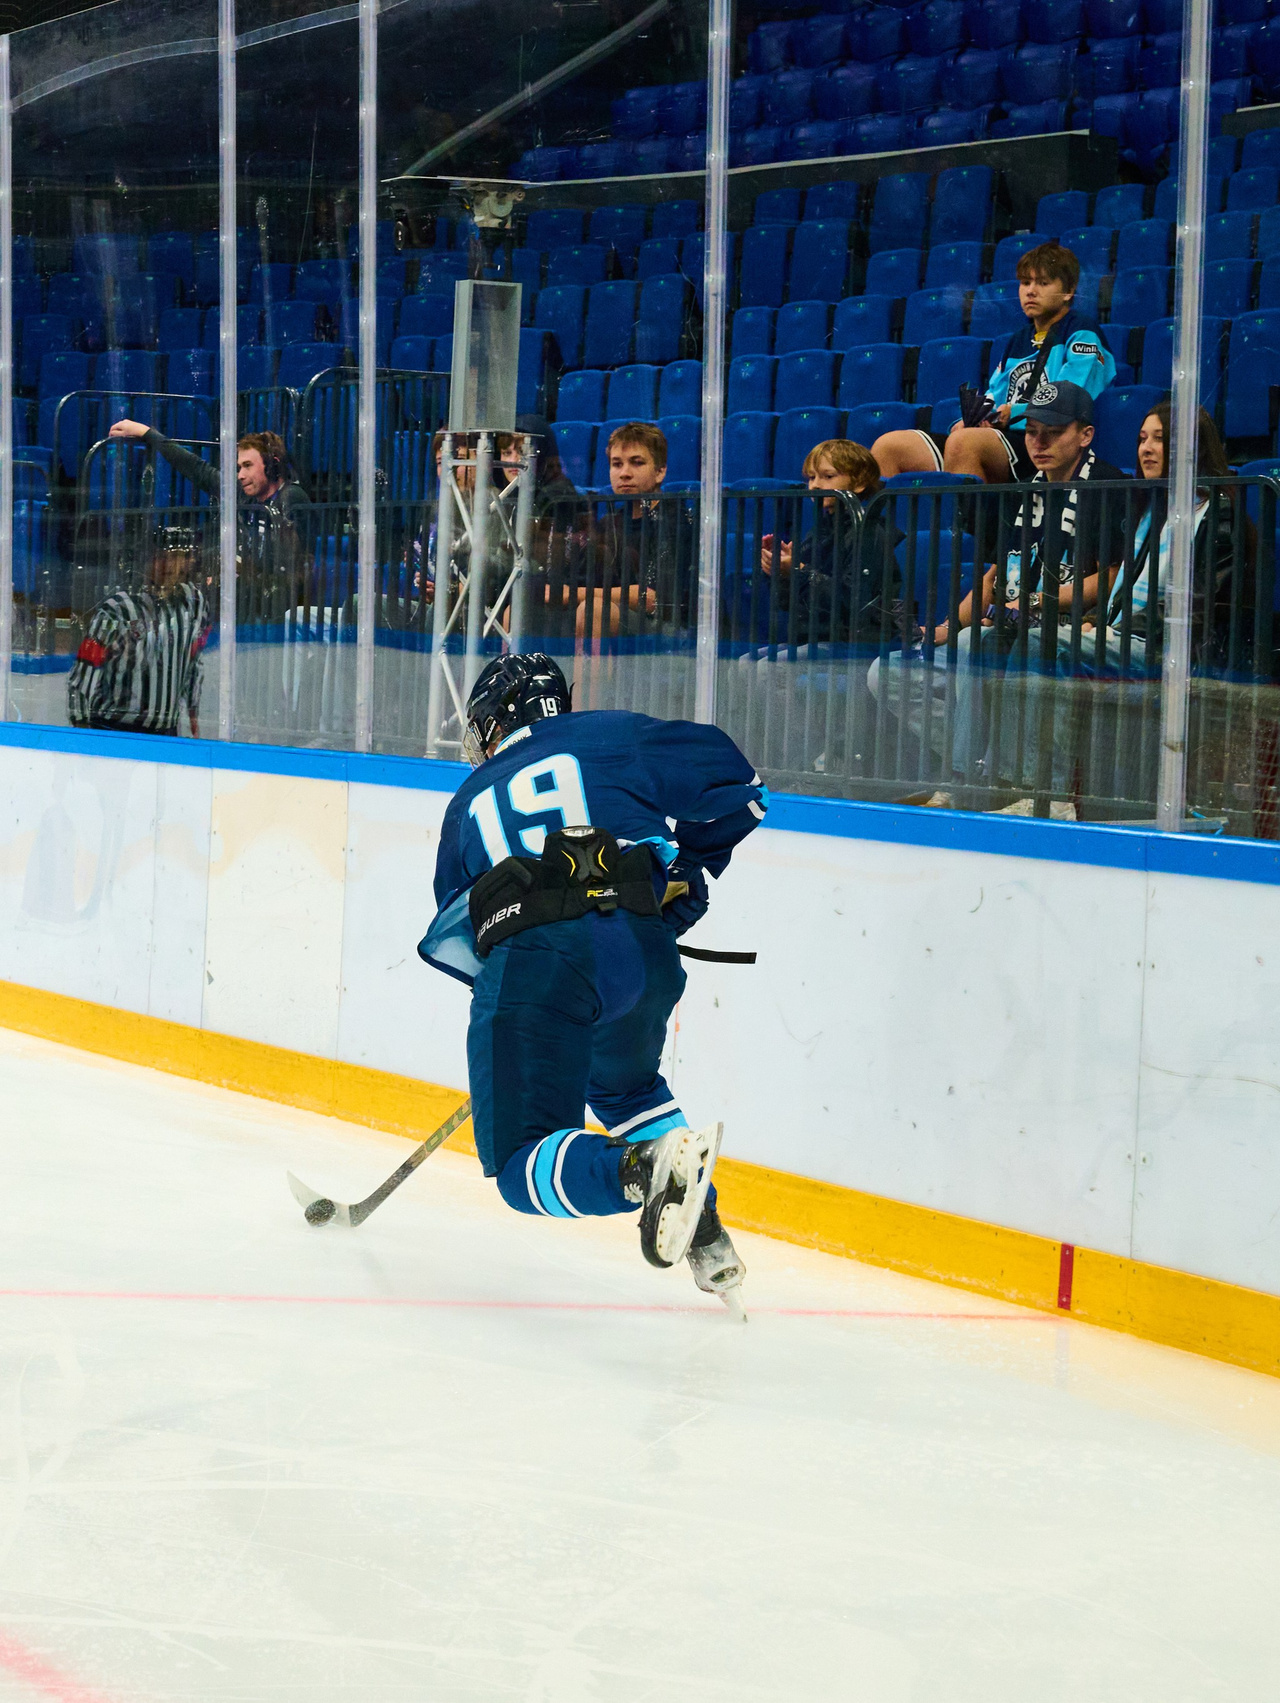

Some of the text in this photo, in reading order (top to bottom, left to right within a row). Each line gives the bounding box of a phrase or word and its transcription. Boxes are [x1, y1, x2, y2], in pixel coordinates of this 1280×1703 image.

[1074, 344, 1098, 353] Winli
[539, 697, 559, 717] 19
[467, 753, 591, 869] 19
[411, 1098, 472, 1168] SOYU
